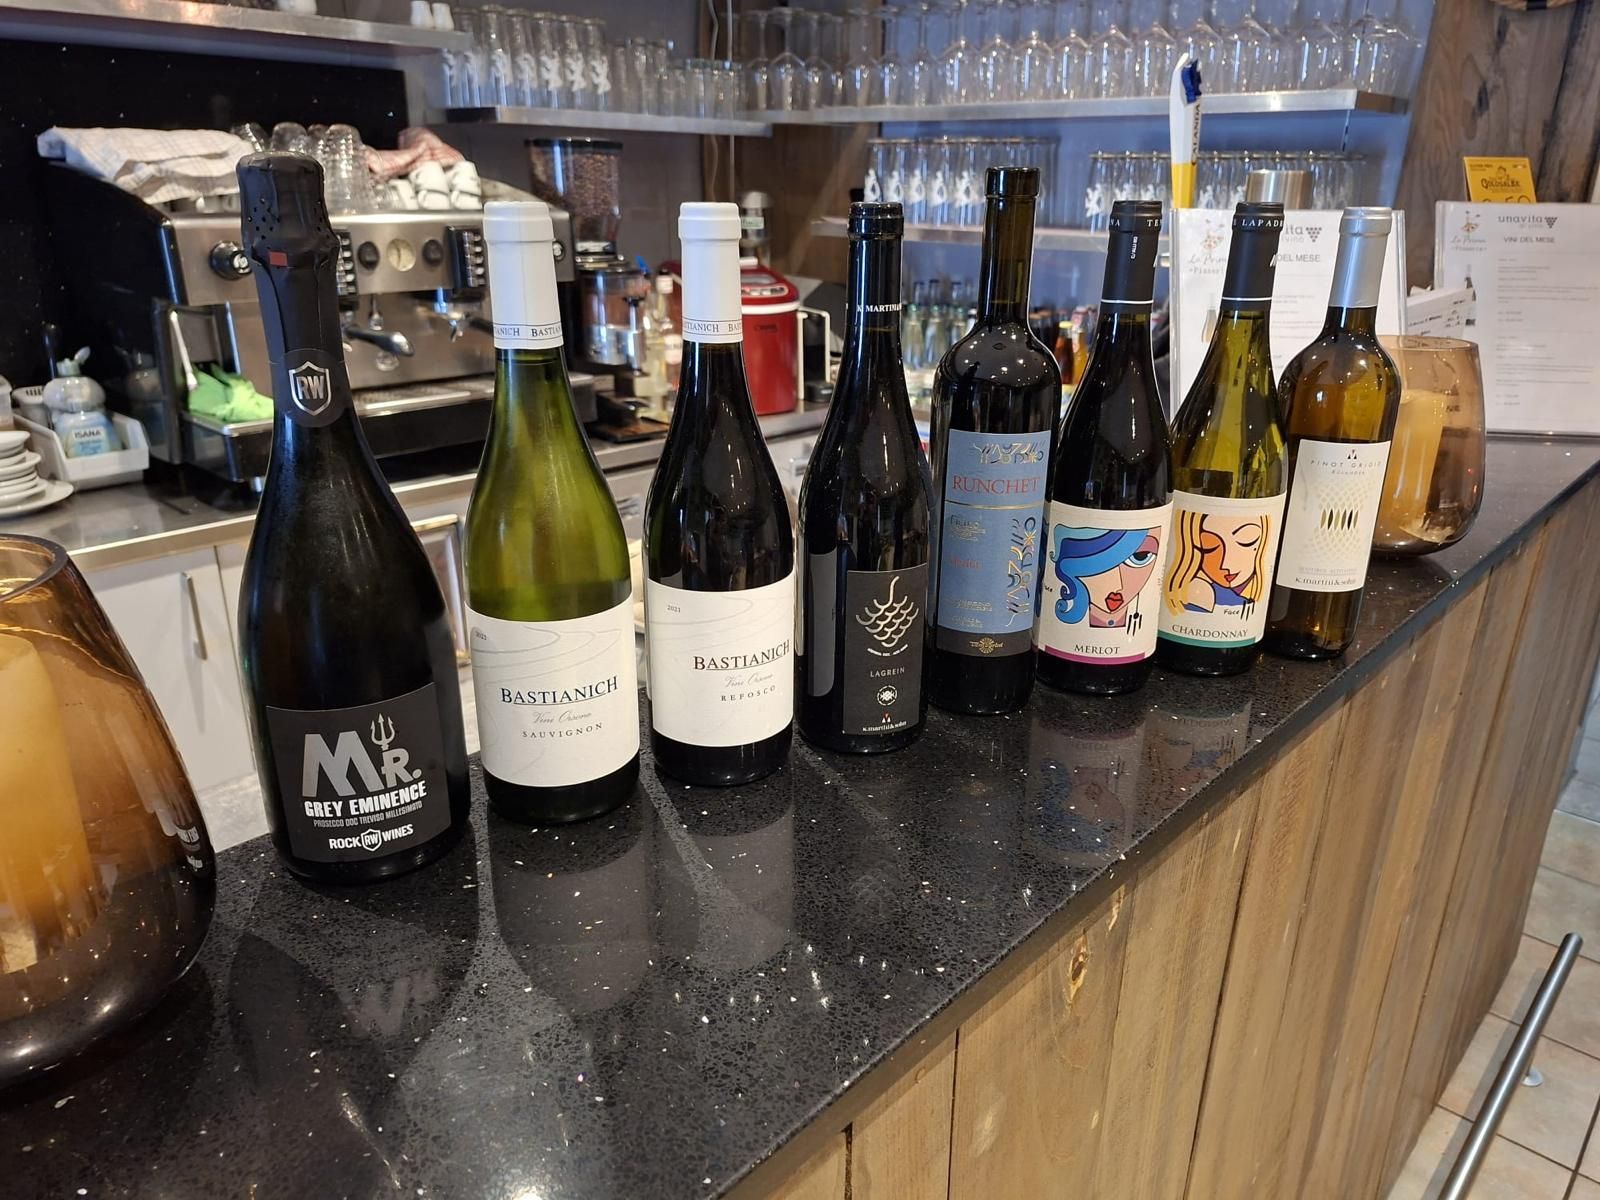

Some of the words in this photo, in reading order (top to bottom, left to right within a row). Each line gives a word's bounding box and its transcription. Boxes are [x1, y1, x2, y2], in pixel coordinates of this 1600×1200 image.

[1295, 254, 1321, 263] MESE
[296, 376, 325, 400] RW
[73, 429, 101, 439] ISANA
[1310, 459, 1344, 468] PINOT
[952, 475, 1041, 495] RUNCHET
[1171, 624, 1248, 640] CHARDONNAY
[693, 639, 791, 671] BASTIANICH
[1073, 644, 1121, 655] MERLOT
[869, 666, 905, 678] LAGREIN
[500, 675, 619, 705] BASTIANICH
[721, 684, 776, 702] REFOSCO
[521, 722, 603, 739] SAUVIGNON
[304, 800, 343, 818] GREY
[349, 780, 427, 816] EMINENCE
[313, 818, 345, 828] PROSECCO
[359, 812, 385, 825] TREVISO
[329, 837, 361, 850] ROCK
[364, 834, 379, 846] RW
[381, 824, 414, 842] WINES
